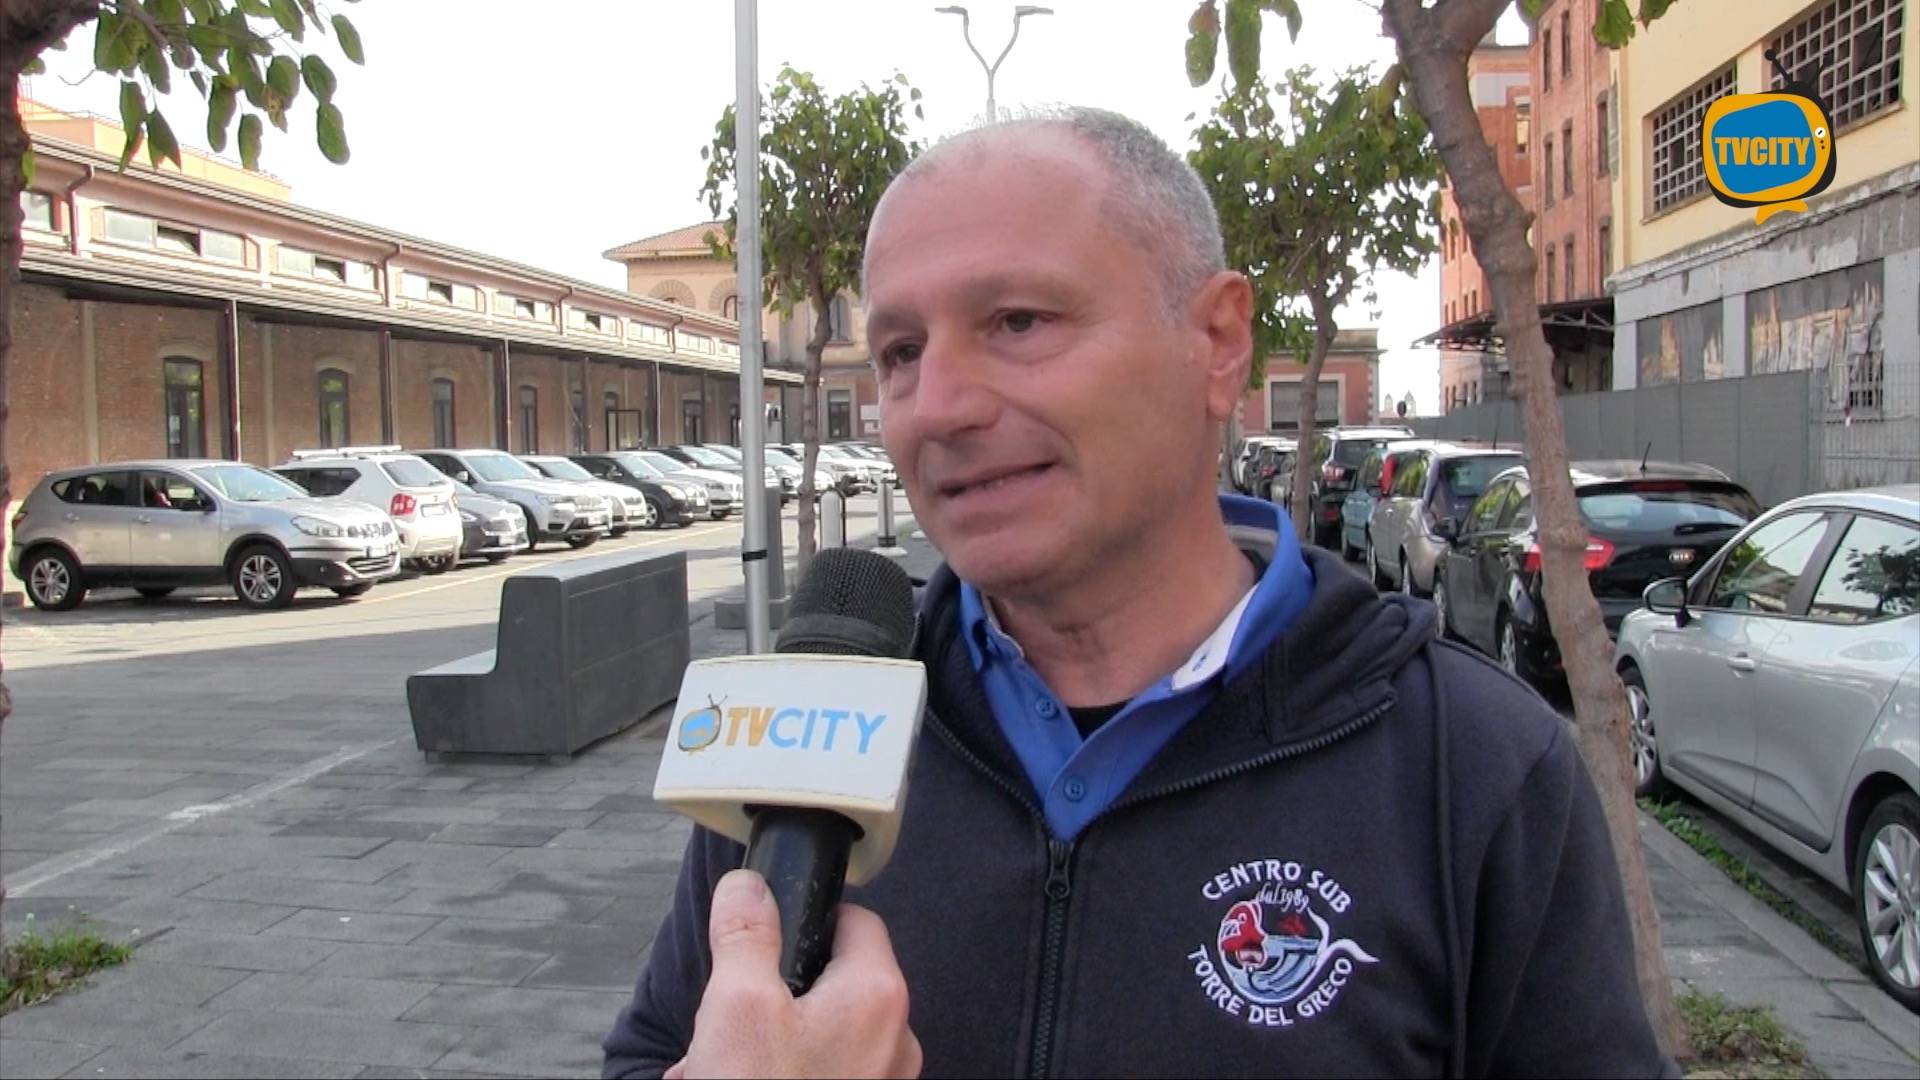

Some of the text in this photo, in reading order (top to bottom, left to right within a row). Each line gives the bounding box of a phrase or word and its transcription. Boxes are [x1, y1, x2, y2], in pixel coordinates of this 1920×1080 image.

[725, 706, 887, 755] TVCITY
[1201, 859, 1352, 913] CENTRO SUB
[1187, 943, 1352, 1026] TORRE DEL GRECO
